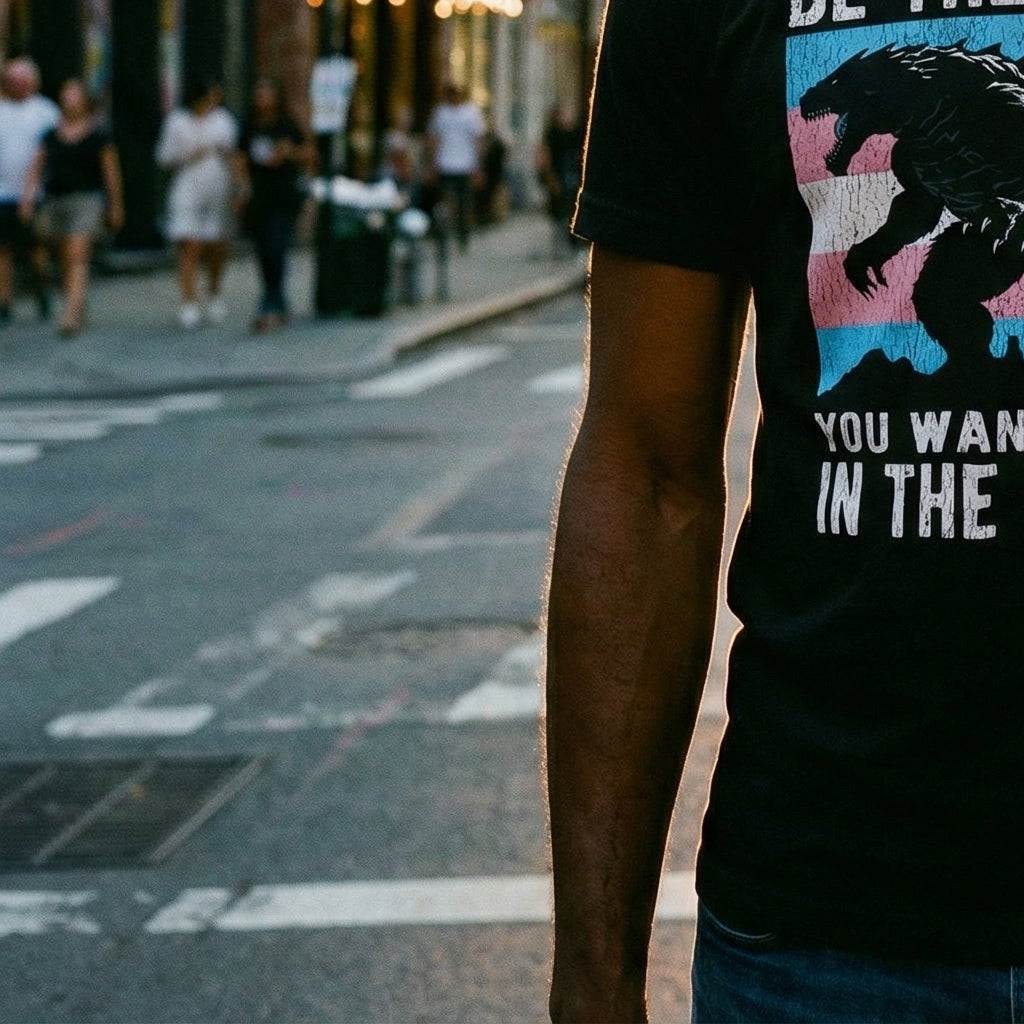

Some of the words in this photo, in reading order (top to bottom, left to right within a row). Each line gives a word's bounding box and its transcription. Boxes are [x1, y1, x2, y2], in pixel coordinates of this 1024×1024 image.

[814, 411, 889, 454] YOU
[815, 461, 863, 536] IN
[883, 462, 998, 540] THE
